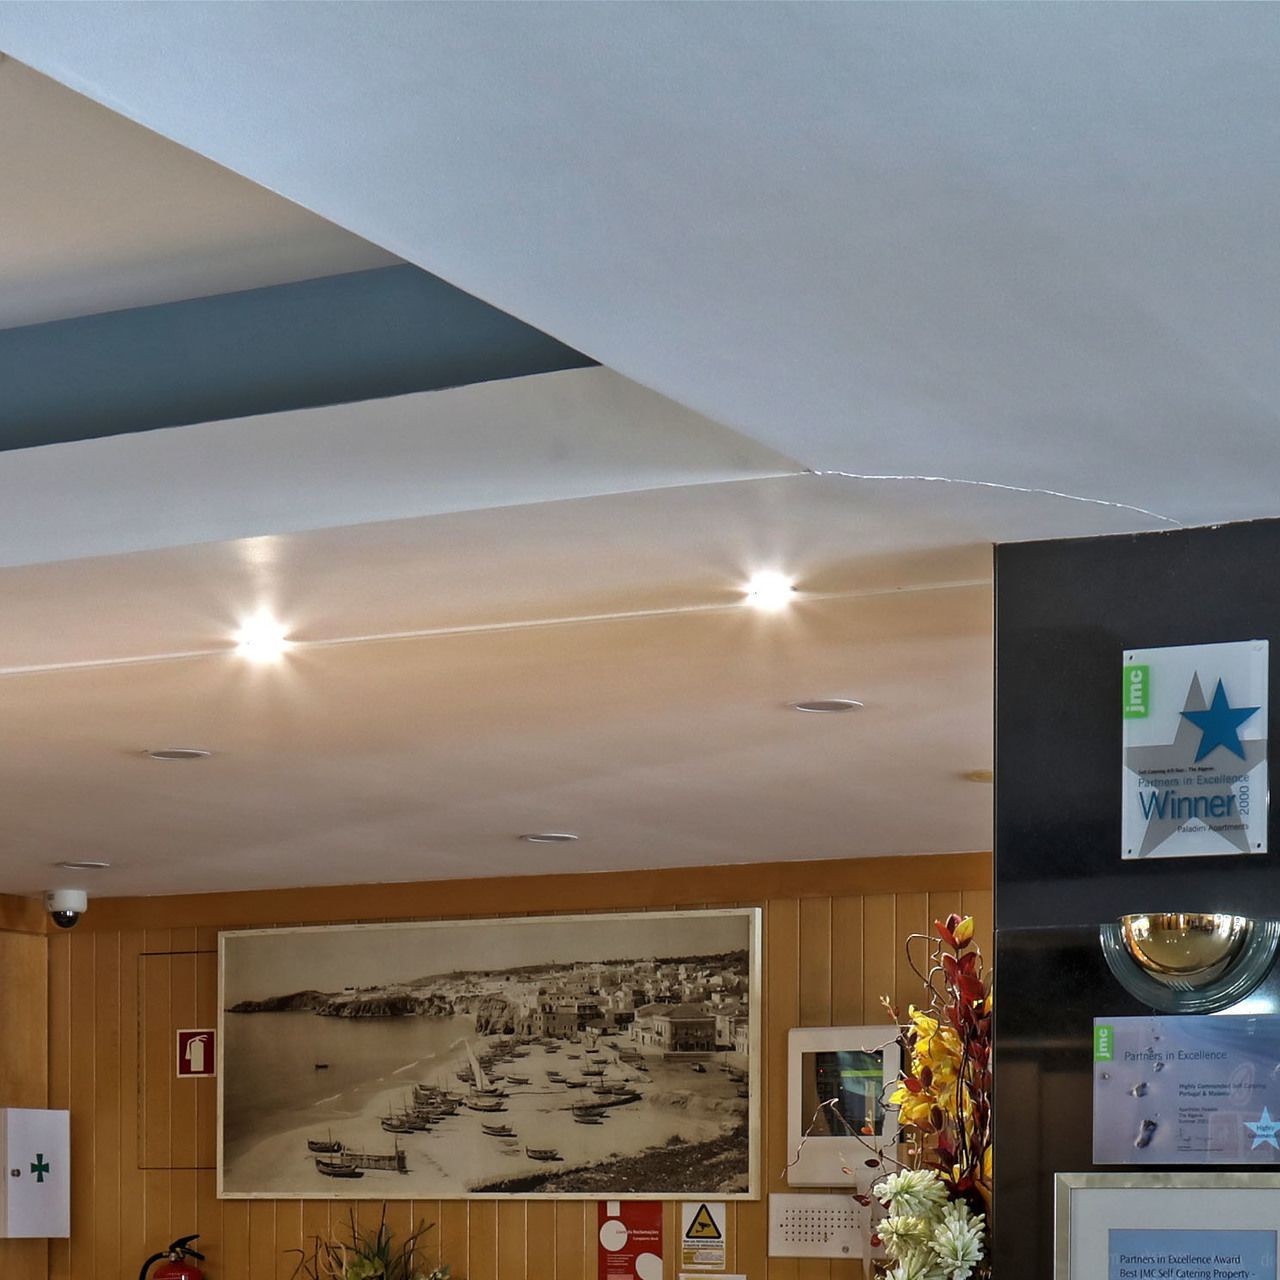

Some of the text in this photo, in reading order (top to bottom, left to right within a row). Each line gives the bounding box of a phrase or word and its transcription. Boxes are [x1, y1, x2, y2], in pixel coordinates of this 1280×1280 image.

[1126, 670, 1145, 713] jmc
[1138, 774, 1249, 788] Partners in Excellence
[1139, 790, 1236, 820] Winner
[1239, 785, 1250, 816] 2000
[1177, 823, 1249, 833] Paladim Apartments
[1096, 1028, 1110, 1057] jmc
[1124, 1049, 1228, 1061] Partners in Excellence
[1120, 1254, 1241, 1265] Partners in Excellence Award
[1120, 1269, 1137, 1278] Best
[1140, 1268, 1156, 1279] JMC
[1158, 1268, 1173, 1278] Self
[1176, 1269, 1211, 1280] Catering
[1213, 1269, 1249, 1280] Property
